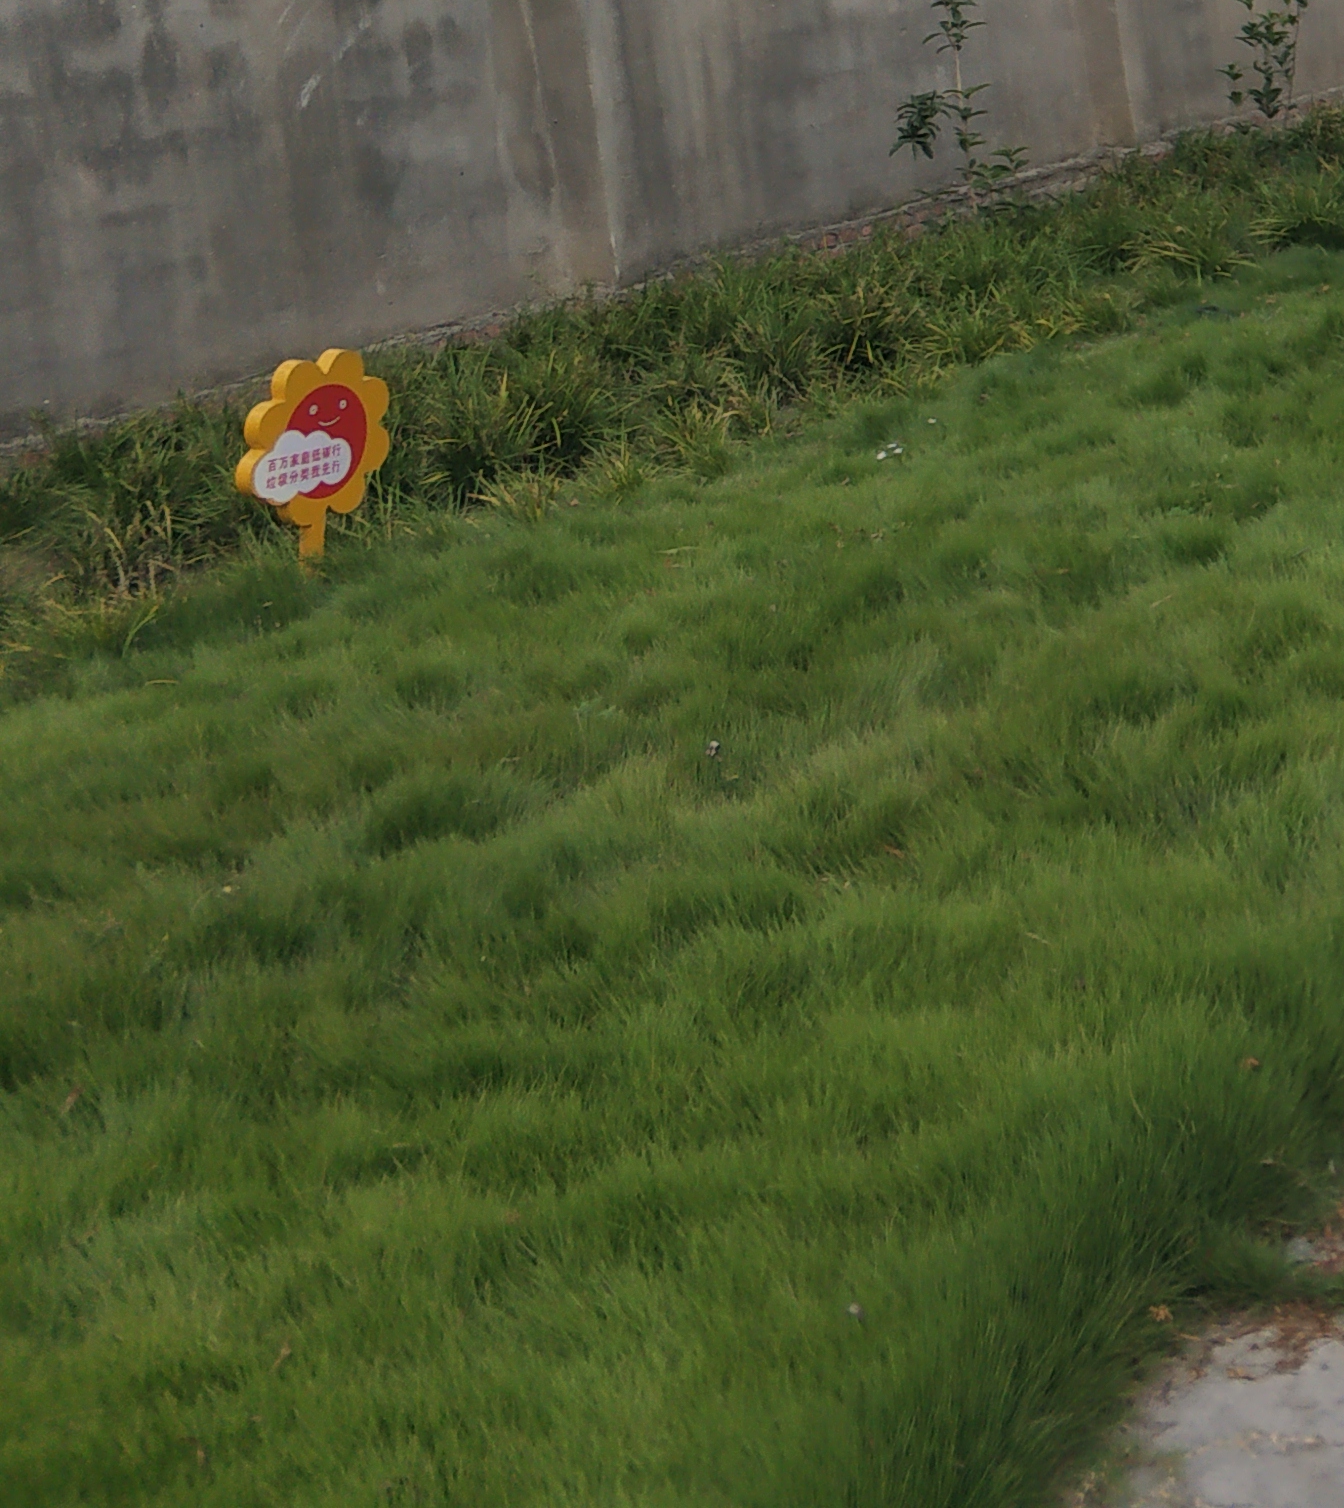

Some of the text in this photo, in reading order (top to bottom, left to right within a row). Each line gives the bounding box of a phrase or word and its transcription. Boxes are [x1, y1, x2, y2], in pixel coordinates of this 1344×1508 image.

[267, 443, 341, 473] 百万家庭低碳行
[266, 460, 340, 490] 垃圾分类我先行
